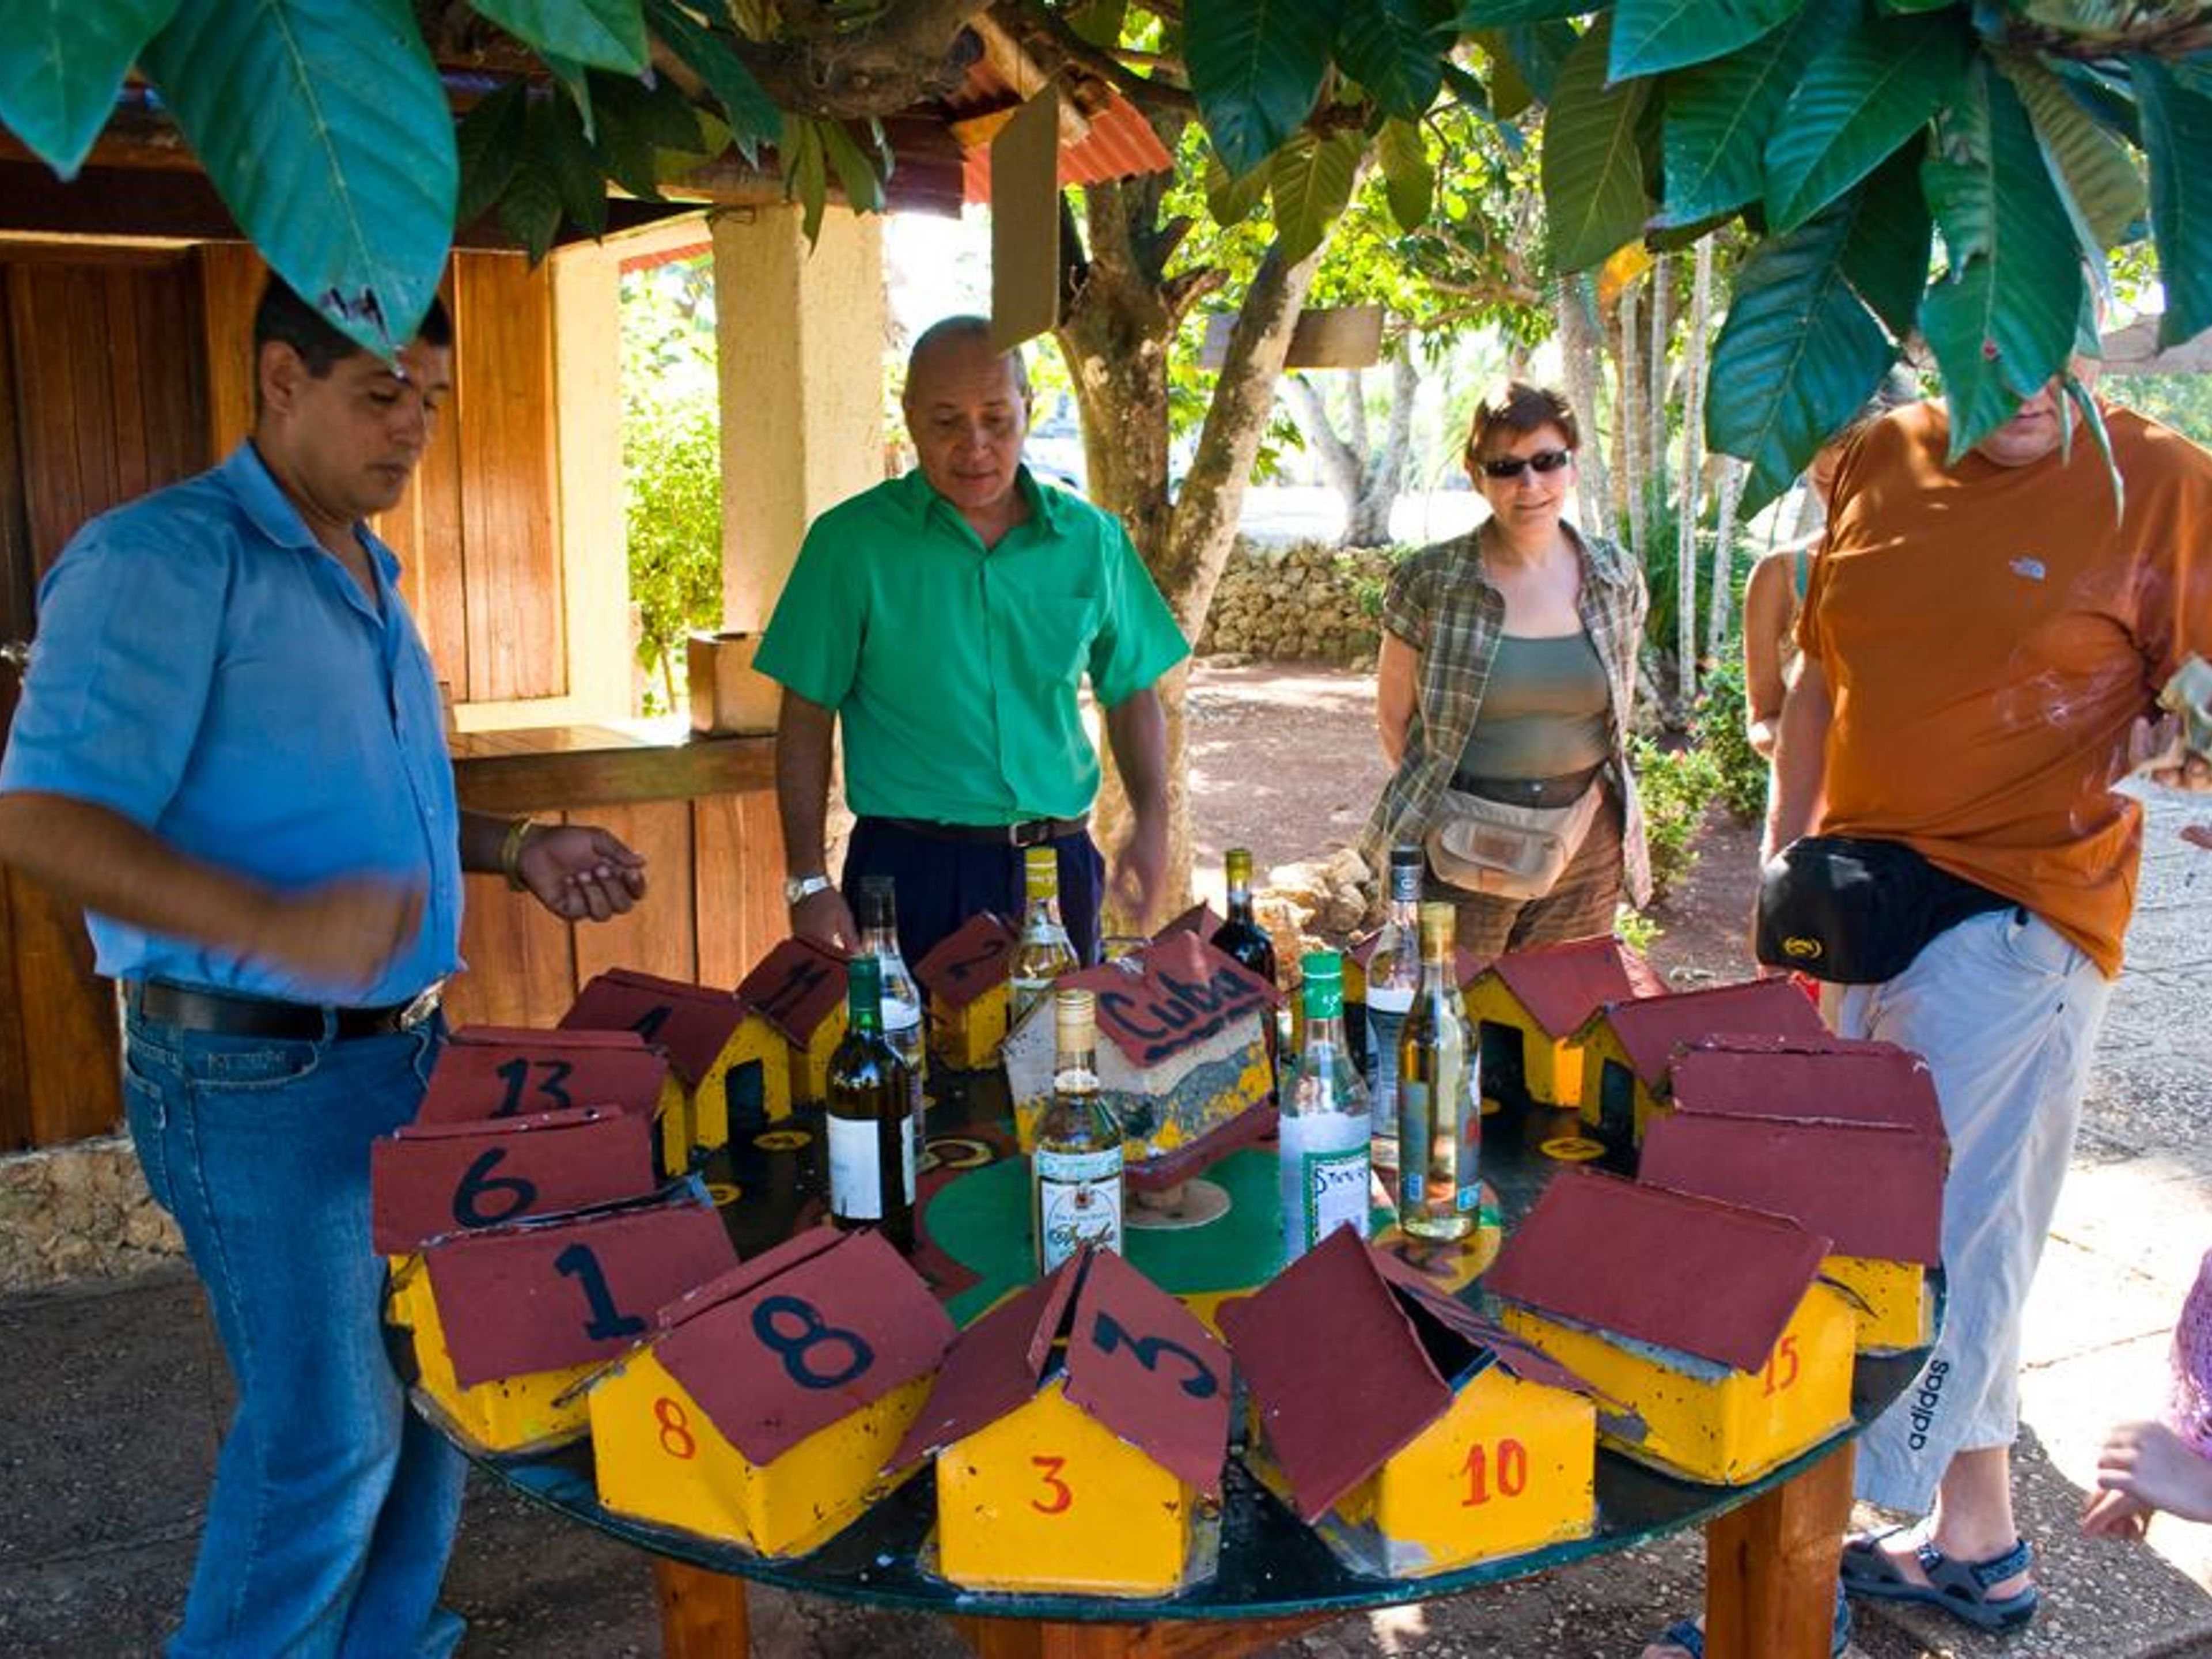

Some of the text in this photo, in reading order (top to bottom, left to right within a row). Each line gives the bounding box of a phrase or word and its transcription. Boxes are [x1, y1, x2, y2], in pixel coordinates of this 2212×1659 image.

[1098, 967, 1260, 1039] Cuba
[488, 1055, 573, 1116] 13
[452, 1146, 537, 1228] 6
[552, 1243, 649, 1341] 1
[751, 1296, 876, 1389] 8
[1092, 1311, 1219, 1399] 3
[1762, 1335, 1799, 1399] 15
[654, 1397, 696, 1460] 8
[1908, 1359, 1950, 1451] adidas
[1031, 1456, 1073, 1515] 3
[1459, 1439, 1527, 1508] 10
